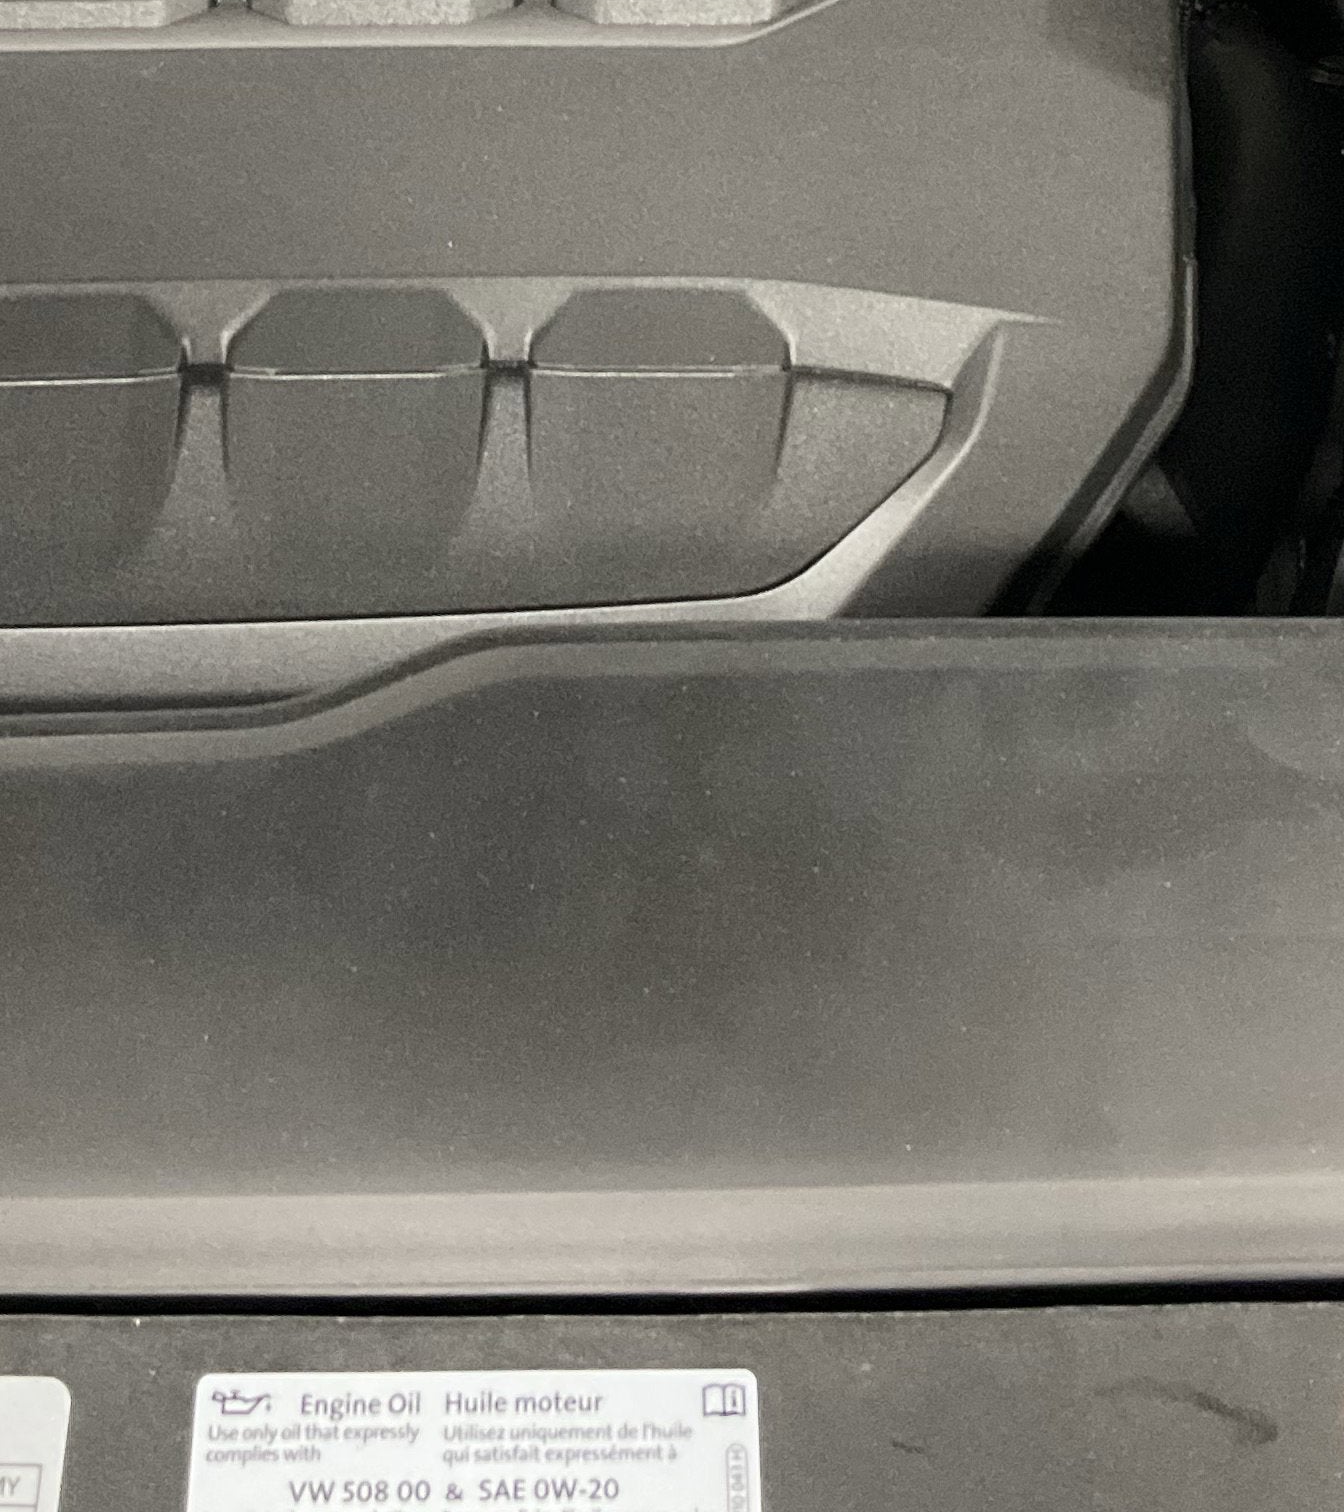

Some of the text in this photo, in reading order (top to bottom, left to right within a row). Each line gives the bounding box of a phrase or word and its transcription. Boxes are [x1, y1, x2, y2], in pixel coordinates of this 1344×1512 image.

[301, 1391, 422, 1421] Engine Oil
[444, 1390, 604, 1414] Huile moteur
[208, 1423, 420, 1444] Use only oil that expressly
[443, 1422, 693, 1444] Utilisez uniquement de l'huile
[206, 1445, 322, 1466] complies with
[442, 1444, 678, 1467] qui satisfait expressément à
[289, 1478, 620, 1503] VW 508 00 & SAE 0W-20
